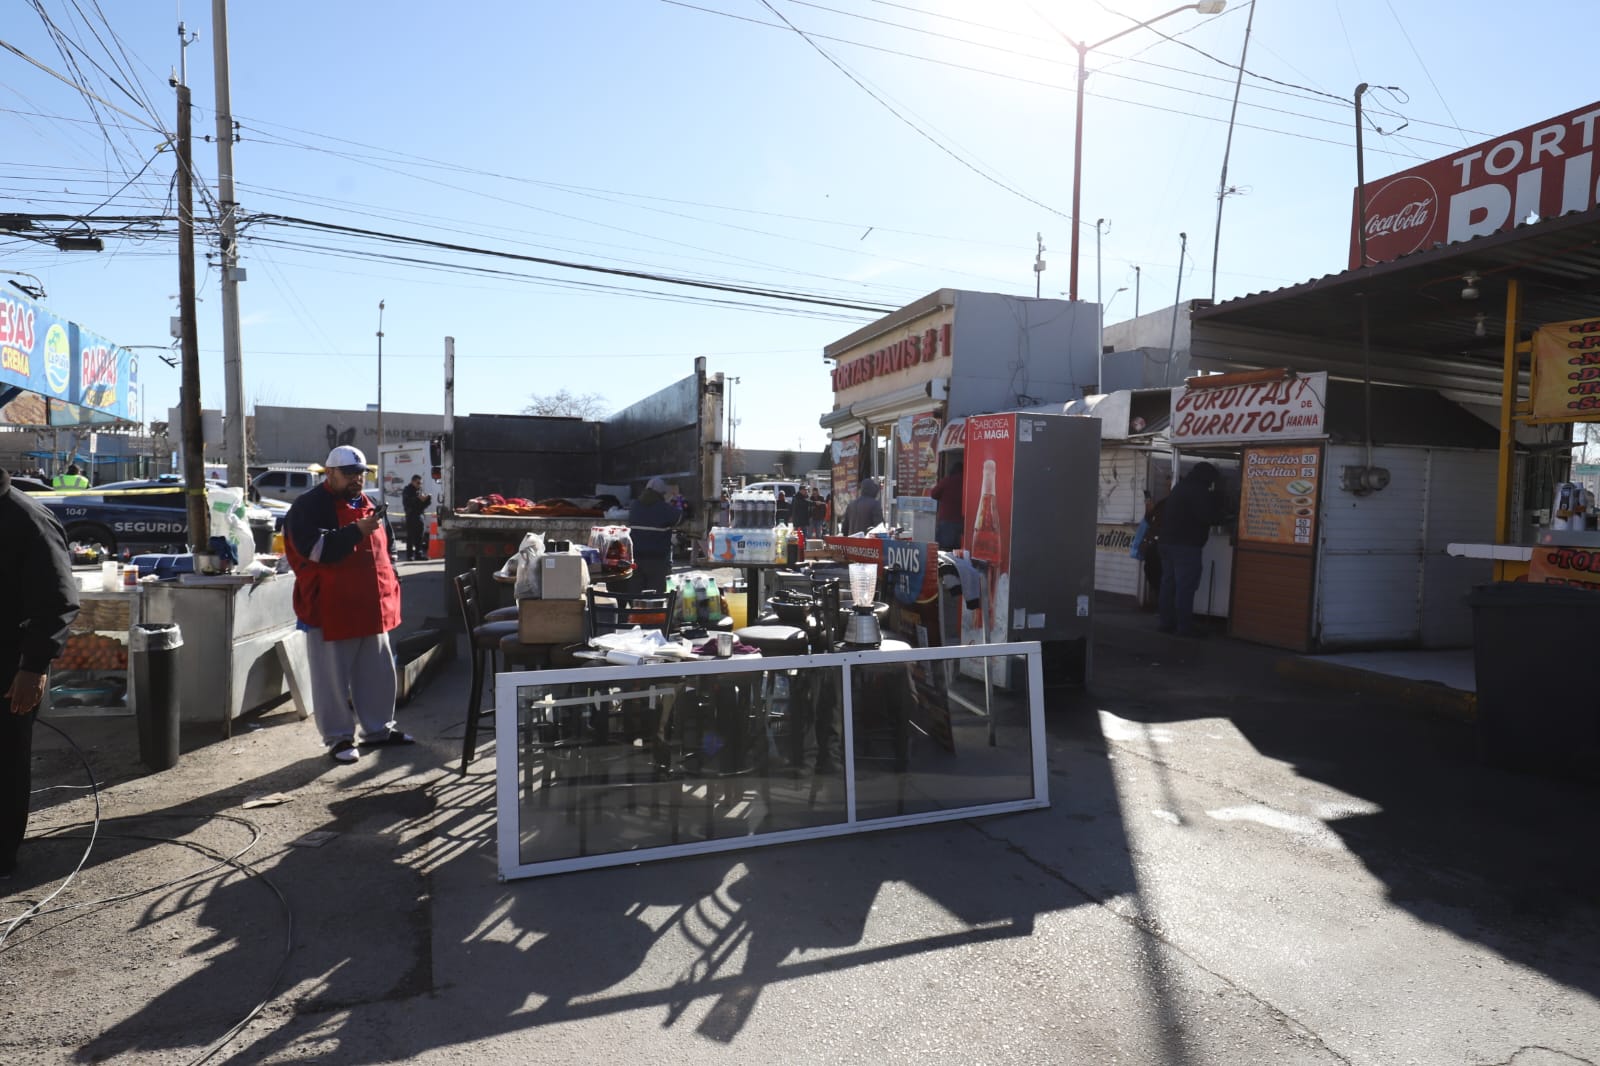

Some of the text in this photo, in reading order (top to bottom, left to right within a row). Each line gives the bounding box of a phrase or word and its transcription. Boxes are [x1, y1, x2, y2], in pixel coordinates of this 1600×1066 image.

[2, 347, 30, 376] CREMA
[831, 353, 876, 392] TORTAS
[874, 335, 921, 376] DAVIS
[1175, 378, 1297, 412] GORDITAS
[1301, 400, 1312, 408] DE
[973, 418, 1009, 430] SABOREA
[1175, 410, 1290, 437] BURRITOS
[1286, 414, 1318, 427] HARINA
[973, 431, 983, 441] LA
[984, 429, 1009, 440] MAGIA
[1247, 453, 1300, 465] Burritos
[1247, 466, 1297, 478] Gorditas
[65, 508, 87, 516] 1047
[888, 547, 920, 573] DAVIS
[899, 574, 910, 595] #1
